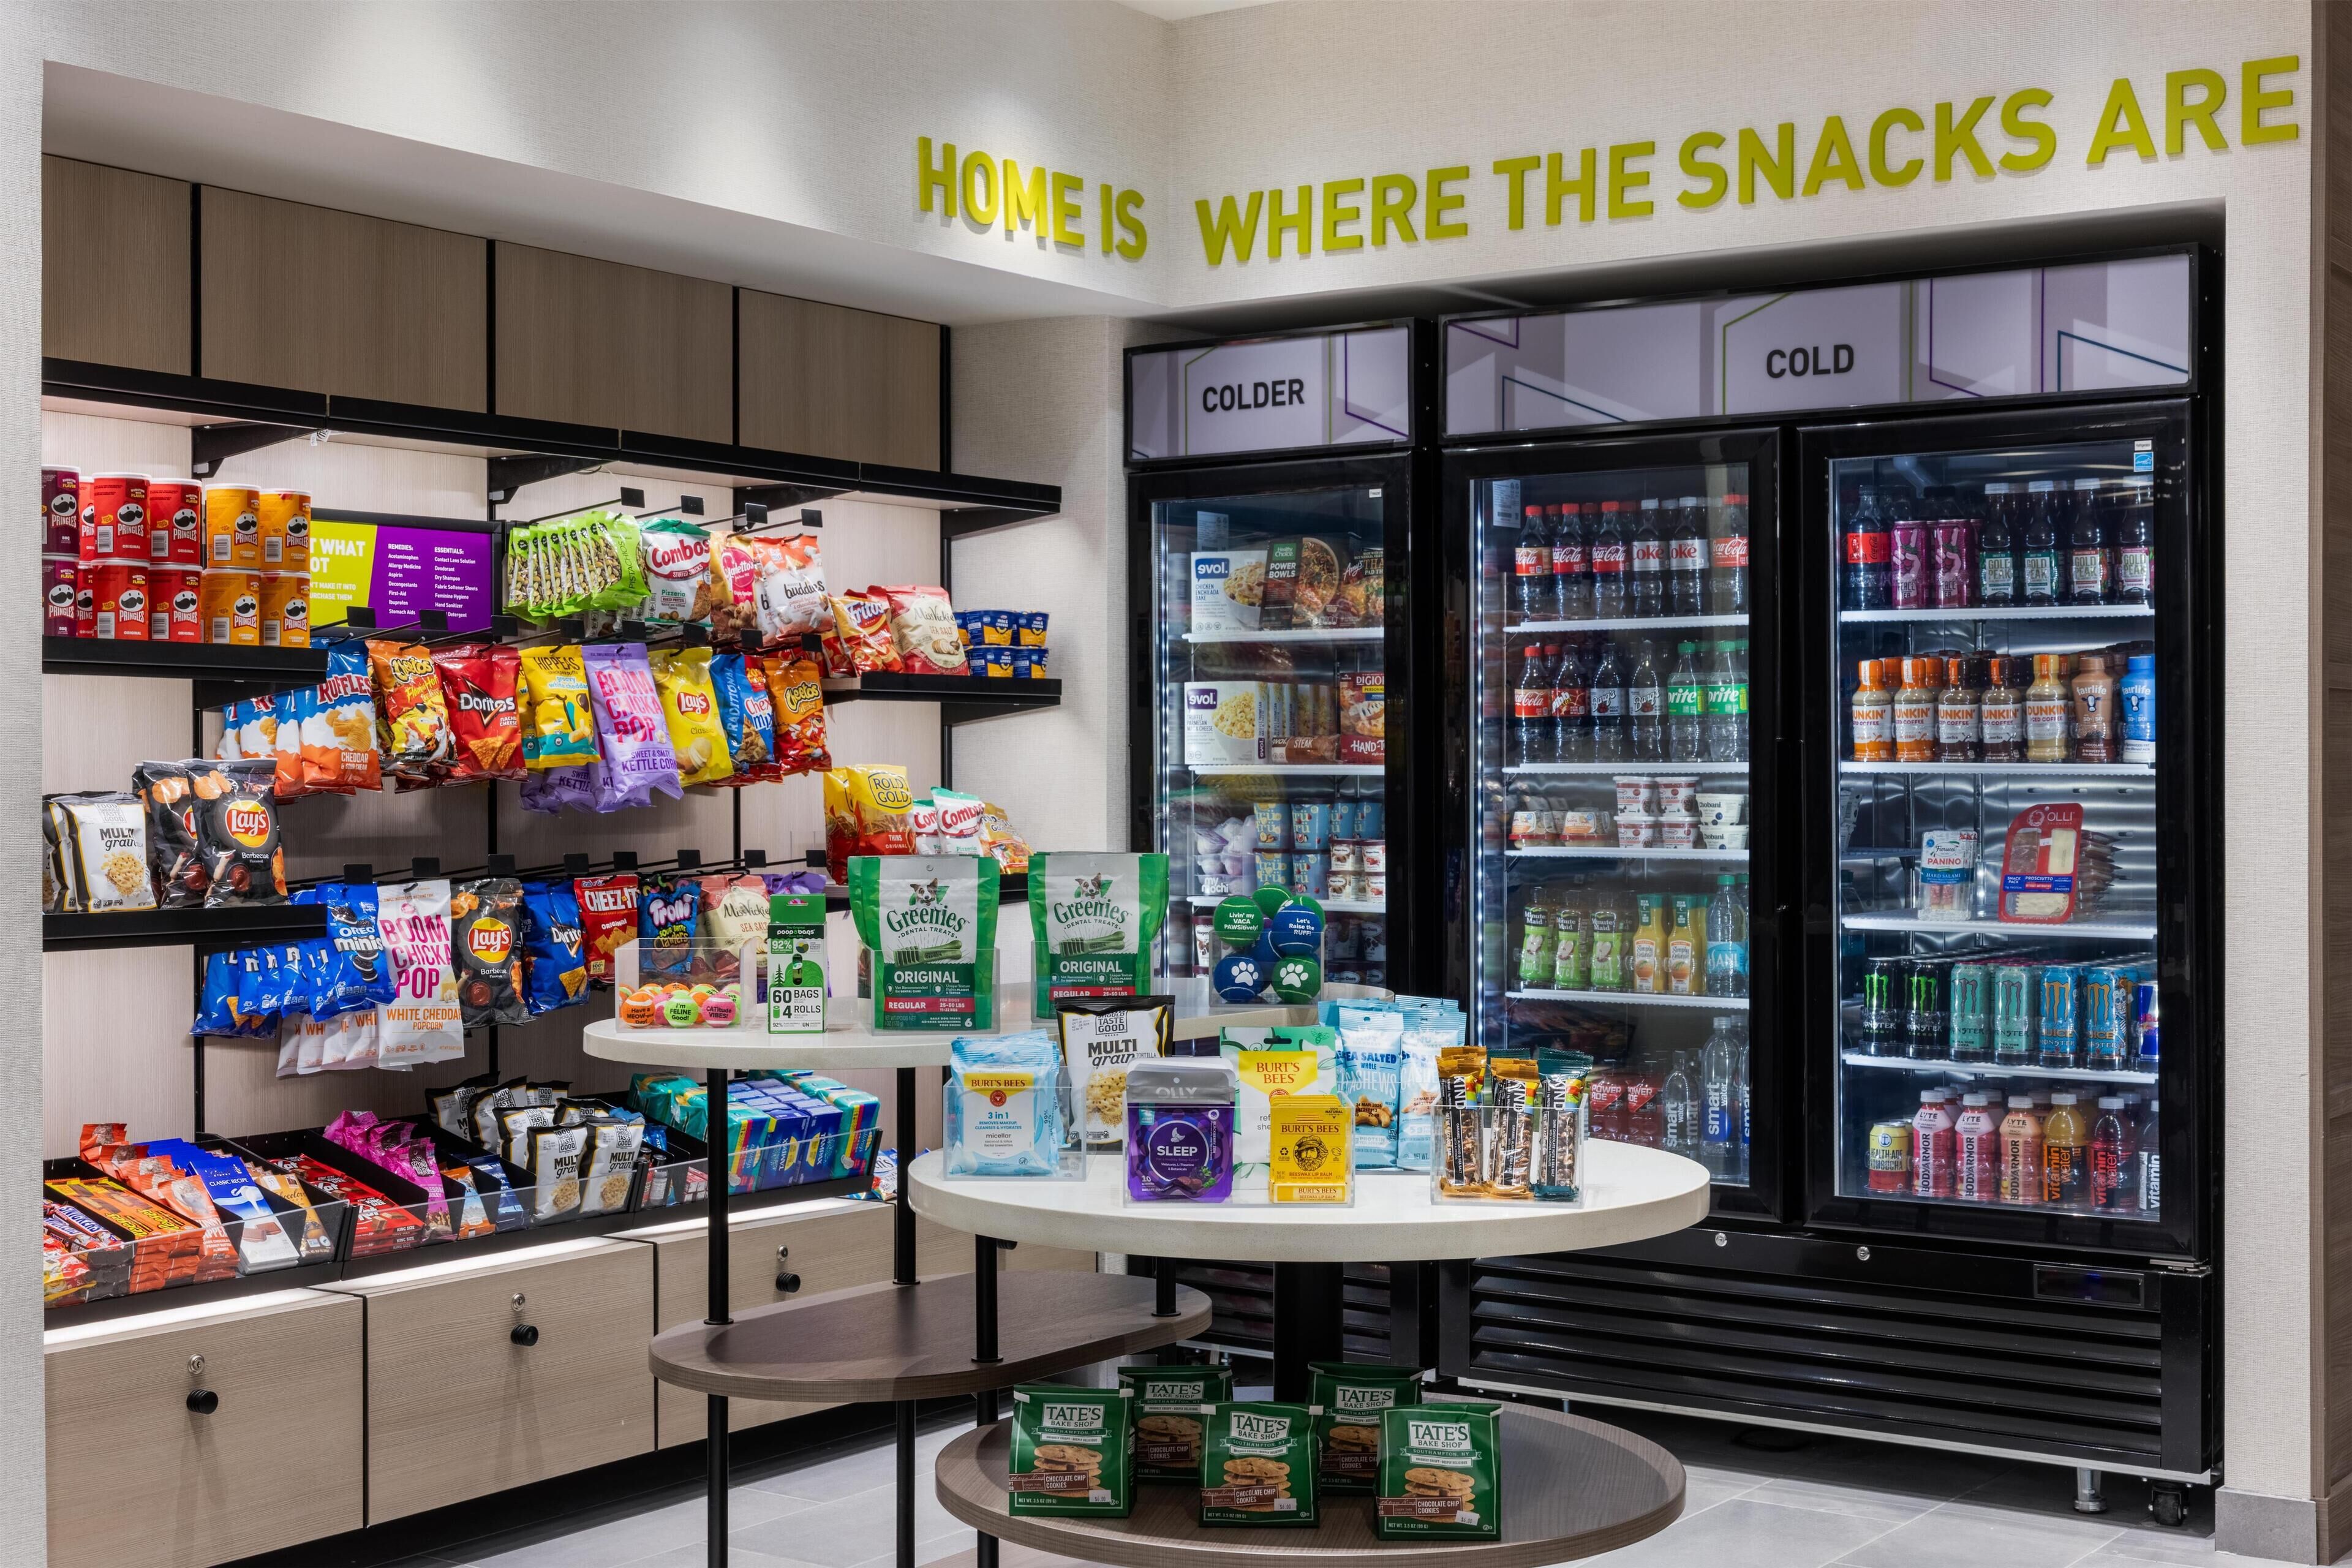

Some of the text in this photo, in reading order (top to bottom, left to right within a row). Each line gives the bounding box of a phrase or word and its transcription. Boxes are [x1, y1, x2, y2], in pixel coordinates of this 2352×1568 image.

[1195, 55, 2299, 265] WHERE THE SNACKS ARE
[918, 137, 1147, 261] HOME IS
[1766, 344, 1855, 378] COLD
[1202, 379, 1305, 412] COLDER
[235, 533, 257, 546] PRINGLES
[320, 538, 365, 556] WHAT
[2075, 556, 2096, 567] GOLD
[784, 581, 824, 598] buddies
[285, 617, 307, 630] PRINGLES
[533, 656, 581, 671] HIPPEAS
[317, 673, 372, 704] RUFFLES
[460, 693, 515, 713] Doritos
[613, 715, 655, 744] POP
[1294, 739, 1314, 748] STEAK
[341, 752, 369, 763] CHEDDAR
[622, 759, 658, 772] KETTLE
[873, 778, 903, 791] ROLD
[232, 810, 266, 836] Lay's
[2047, 812, 2073, 822] OLLI
[649, 893, 692, 926] Trolli
[1054, 899, 1128, 924] Greenies
[1525, 911, 1545, 919] Minute
[886, 905, 966, 932] Greenies
[1066, 919, 1119, 929] DENTAL TREATS
[339, 925, 375, 938] OREO
[380, 914, 450, 946] BOOM
[900, 927, 956, 938] DENTAL TREATS
[334, 935, 383, 952] minis
[772, 940, 792, 949] 92%
[393, 944, 451, 969] CHICKA
[1060, 960, 1122, 973] ORIGINAL
[395, 967, 440, 1000] POP
[894, 971, 959, 983] ORIGINAL
[773, 990, 819, 1004] 60 BAGS
[387, 1009, 420, 1020] WHITE
[782, 1005, 792, 1019] 4
[965, 1018, 973, 1028] 6
[1098, 1017, 1125, 1025] TASTE
[1088, 1039, 1137, 1058] MULTI
[1361, 1052, 1396, 1064] SALTED
[1256, 1062, 1300, 1072] BURT'S
[1264, 1074, 1295, 1084] BEES
[1156, 1087, 1197, 1098] OLLY
[1453, 1076, 1466, 1110] KIND
[1708, 1082, 1719, 1135] smart
[1316, 1125, 1339, 1133] BEES
[609, 1151, 635, 1163] MULTI
[778, 1137, 788, 1171] TAMPAX
[1157, 1145, 1197, 1156] SLEEP
[1966, 1136, 1975, 1196] BODYARMOR
[2010, 1140, 2019, 1200] BODYARMOR
[2049, 1147, 2071, 1200] vitamin water
[209, 1178, 230, 1187] CLASSIC
[1046, 1406, 1101, 1421] TATE'S
[1234, 1415, 1286, 1433] TATE'S
[1238, 1430, 1257, 1439] BAKE
[1411, 1425, 1468, 1441] TATE'S
